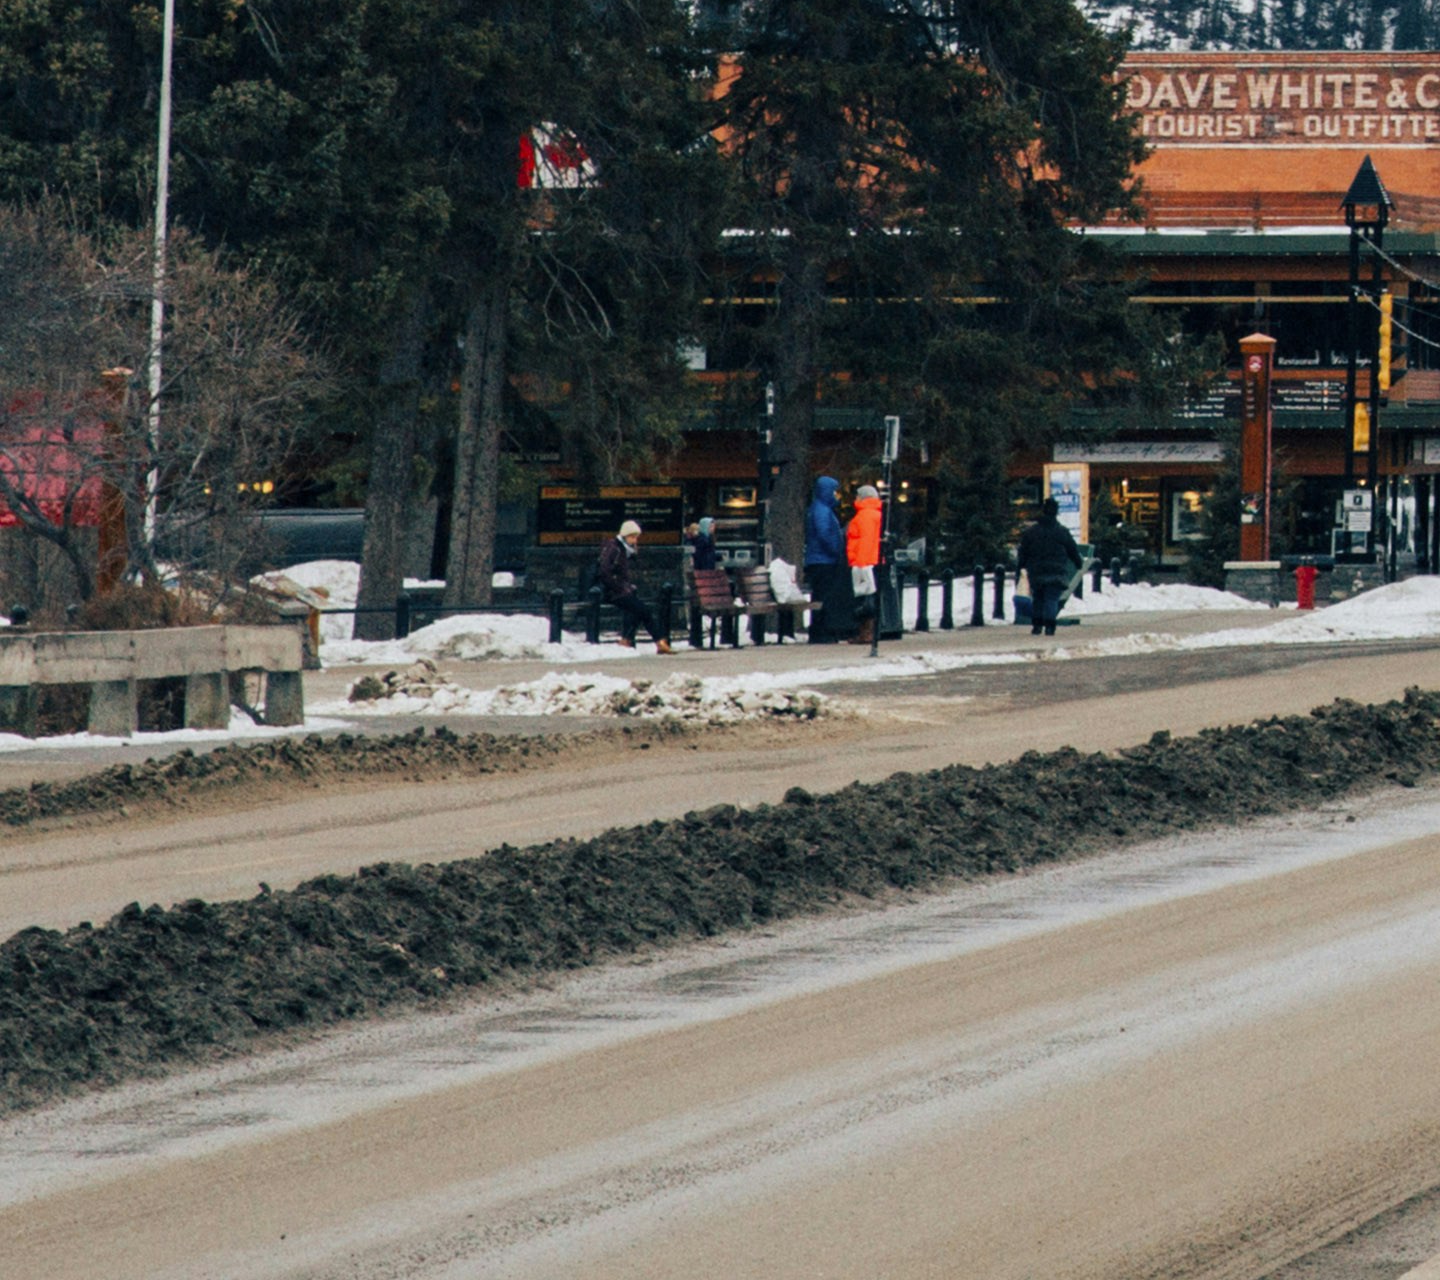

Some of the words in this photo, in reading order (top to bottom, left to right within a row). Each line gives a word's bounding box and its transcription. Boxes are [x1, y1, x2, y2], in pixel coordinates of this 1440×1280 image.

[1125, 73, 1238, 110] DAVE
[1245, 73, 1378, 110] WHITE
[1385, 76, 1410, 110] &
[1142, 114, 1262, 138] TOURIST
